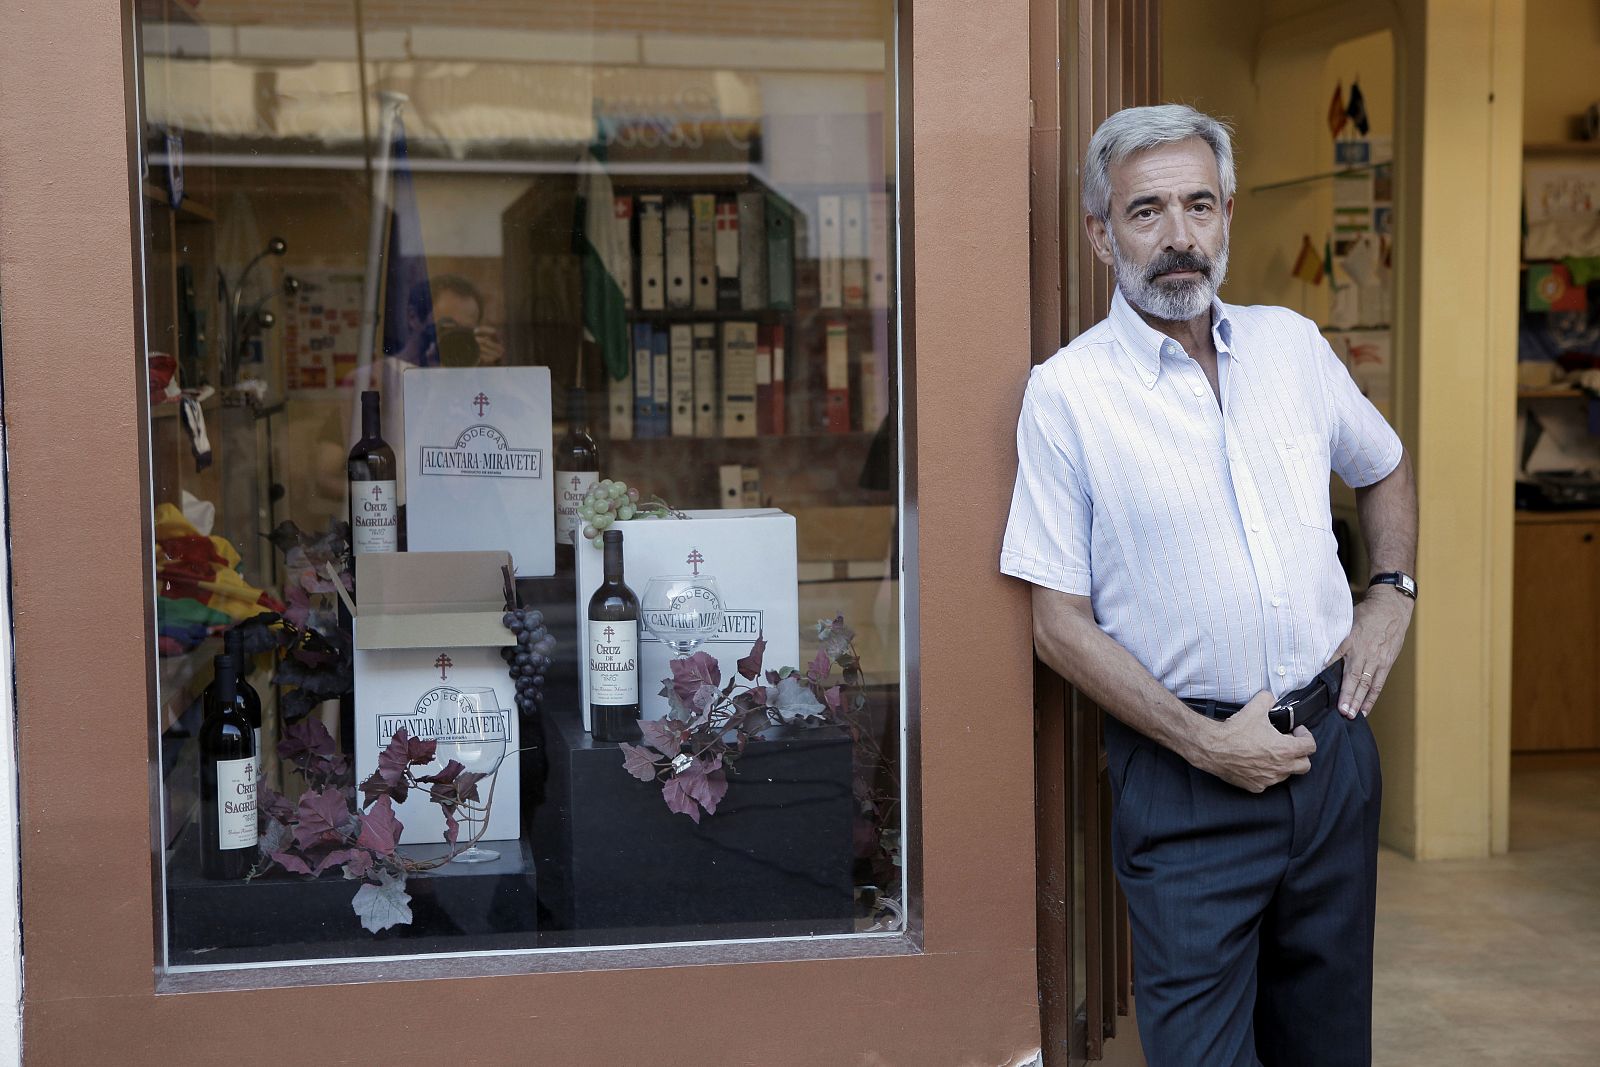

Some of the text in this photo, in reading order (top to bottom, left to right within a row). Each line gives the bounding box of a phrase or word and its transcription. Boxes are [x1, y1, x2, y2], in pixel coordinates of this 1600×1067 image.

[458, 427, 507, 451] BODEGAS
[596, 643, 621, 655] CRUZ
[590, 658, 635, 672] SAGRILLAS
[418, 691, 472, 715] BODEGAS
